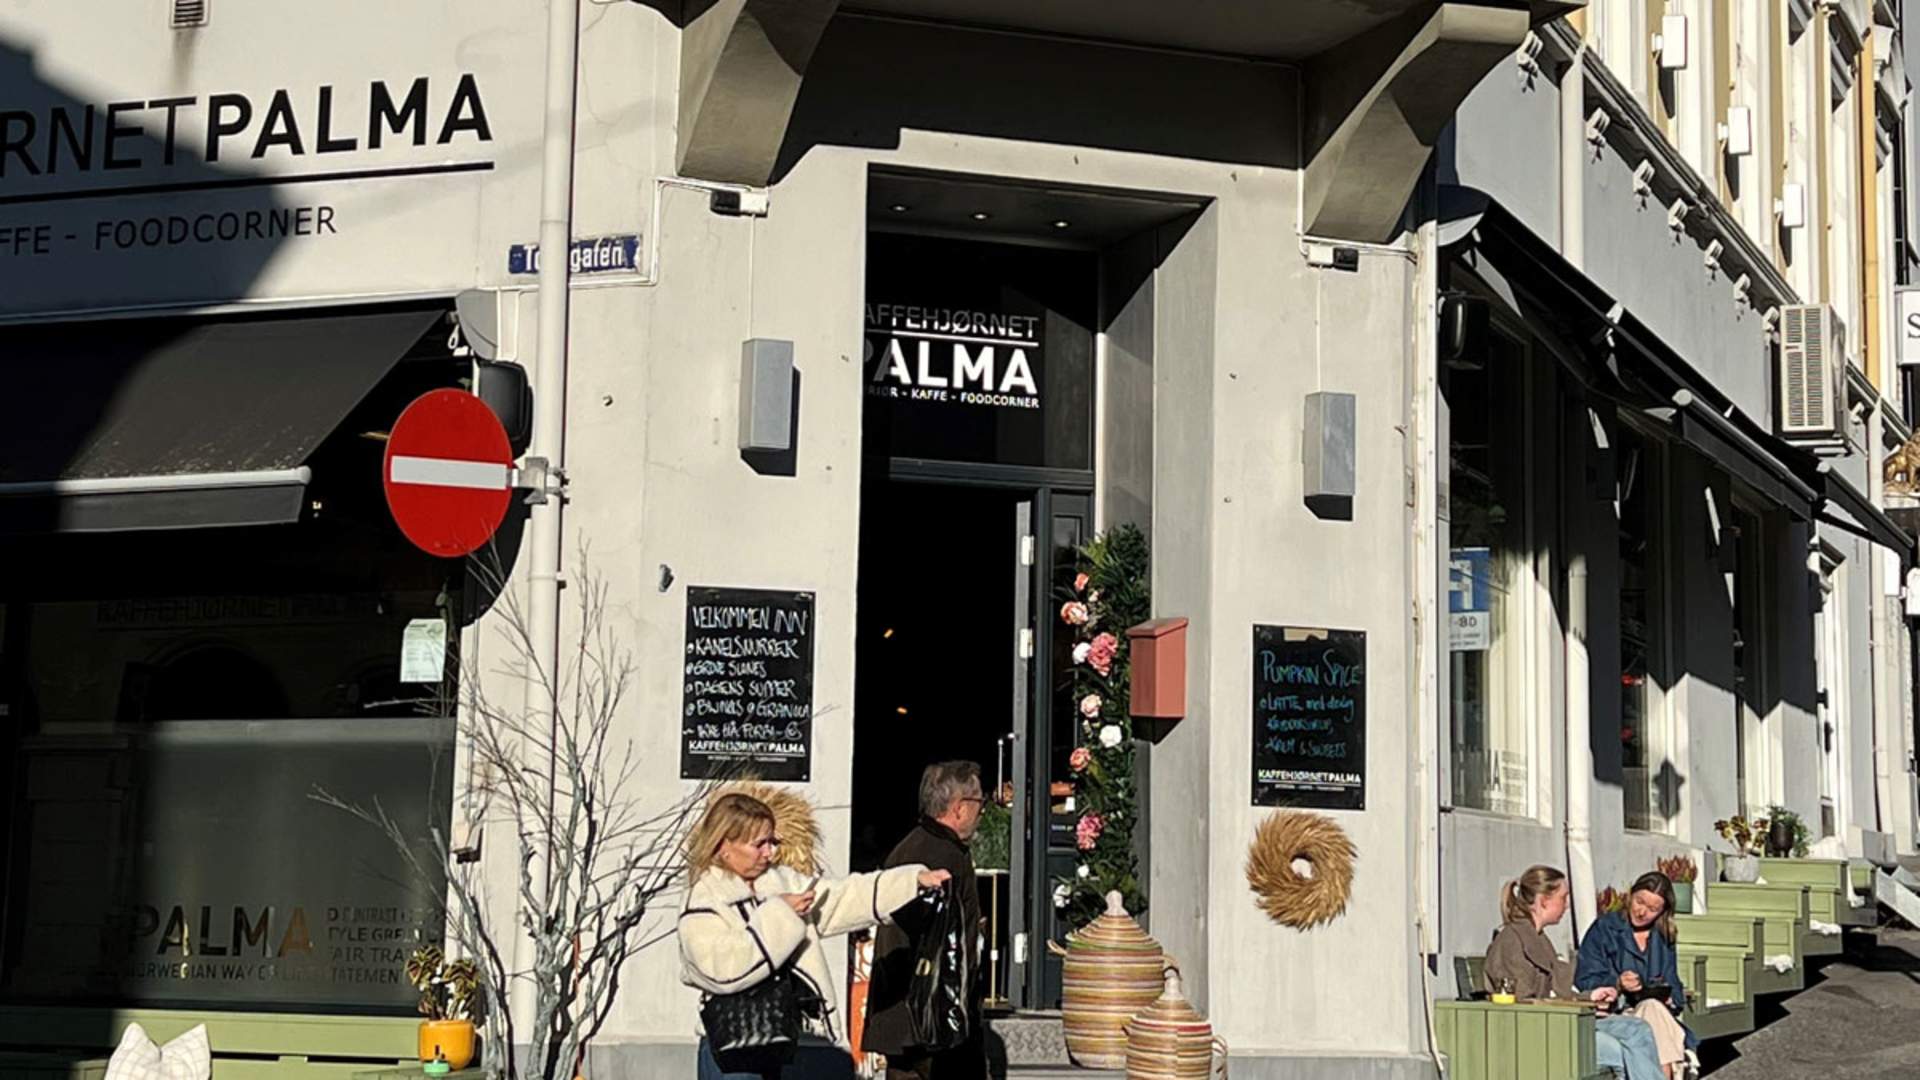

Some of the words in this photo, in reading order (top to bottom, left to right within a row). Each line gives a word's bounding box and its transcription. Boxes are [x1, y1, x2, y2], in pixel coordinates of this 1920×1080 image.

[95, 205, 337, 251] FOODCORNER
[911, 389, 948, 401] KAFFE
[960, 391, 1039, 408] FOODCORNER
[692, 606, 770, 630] VELKOMMEN
[128, 905, 313, 958] PALMA
